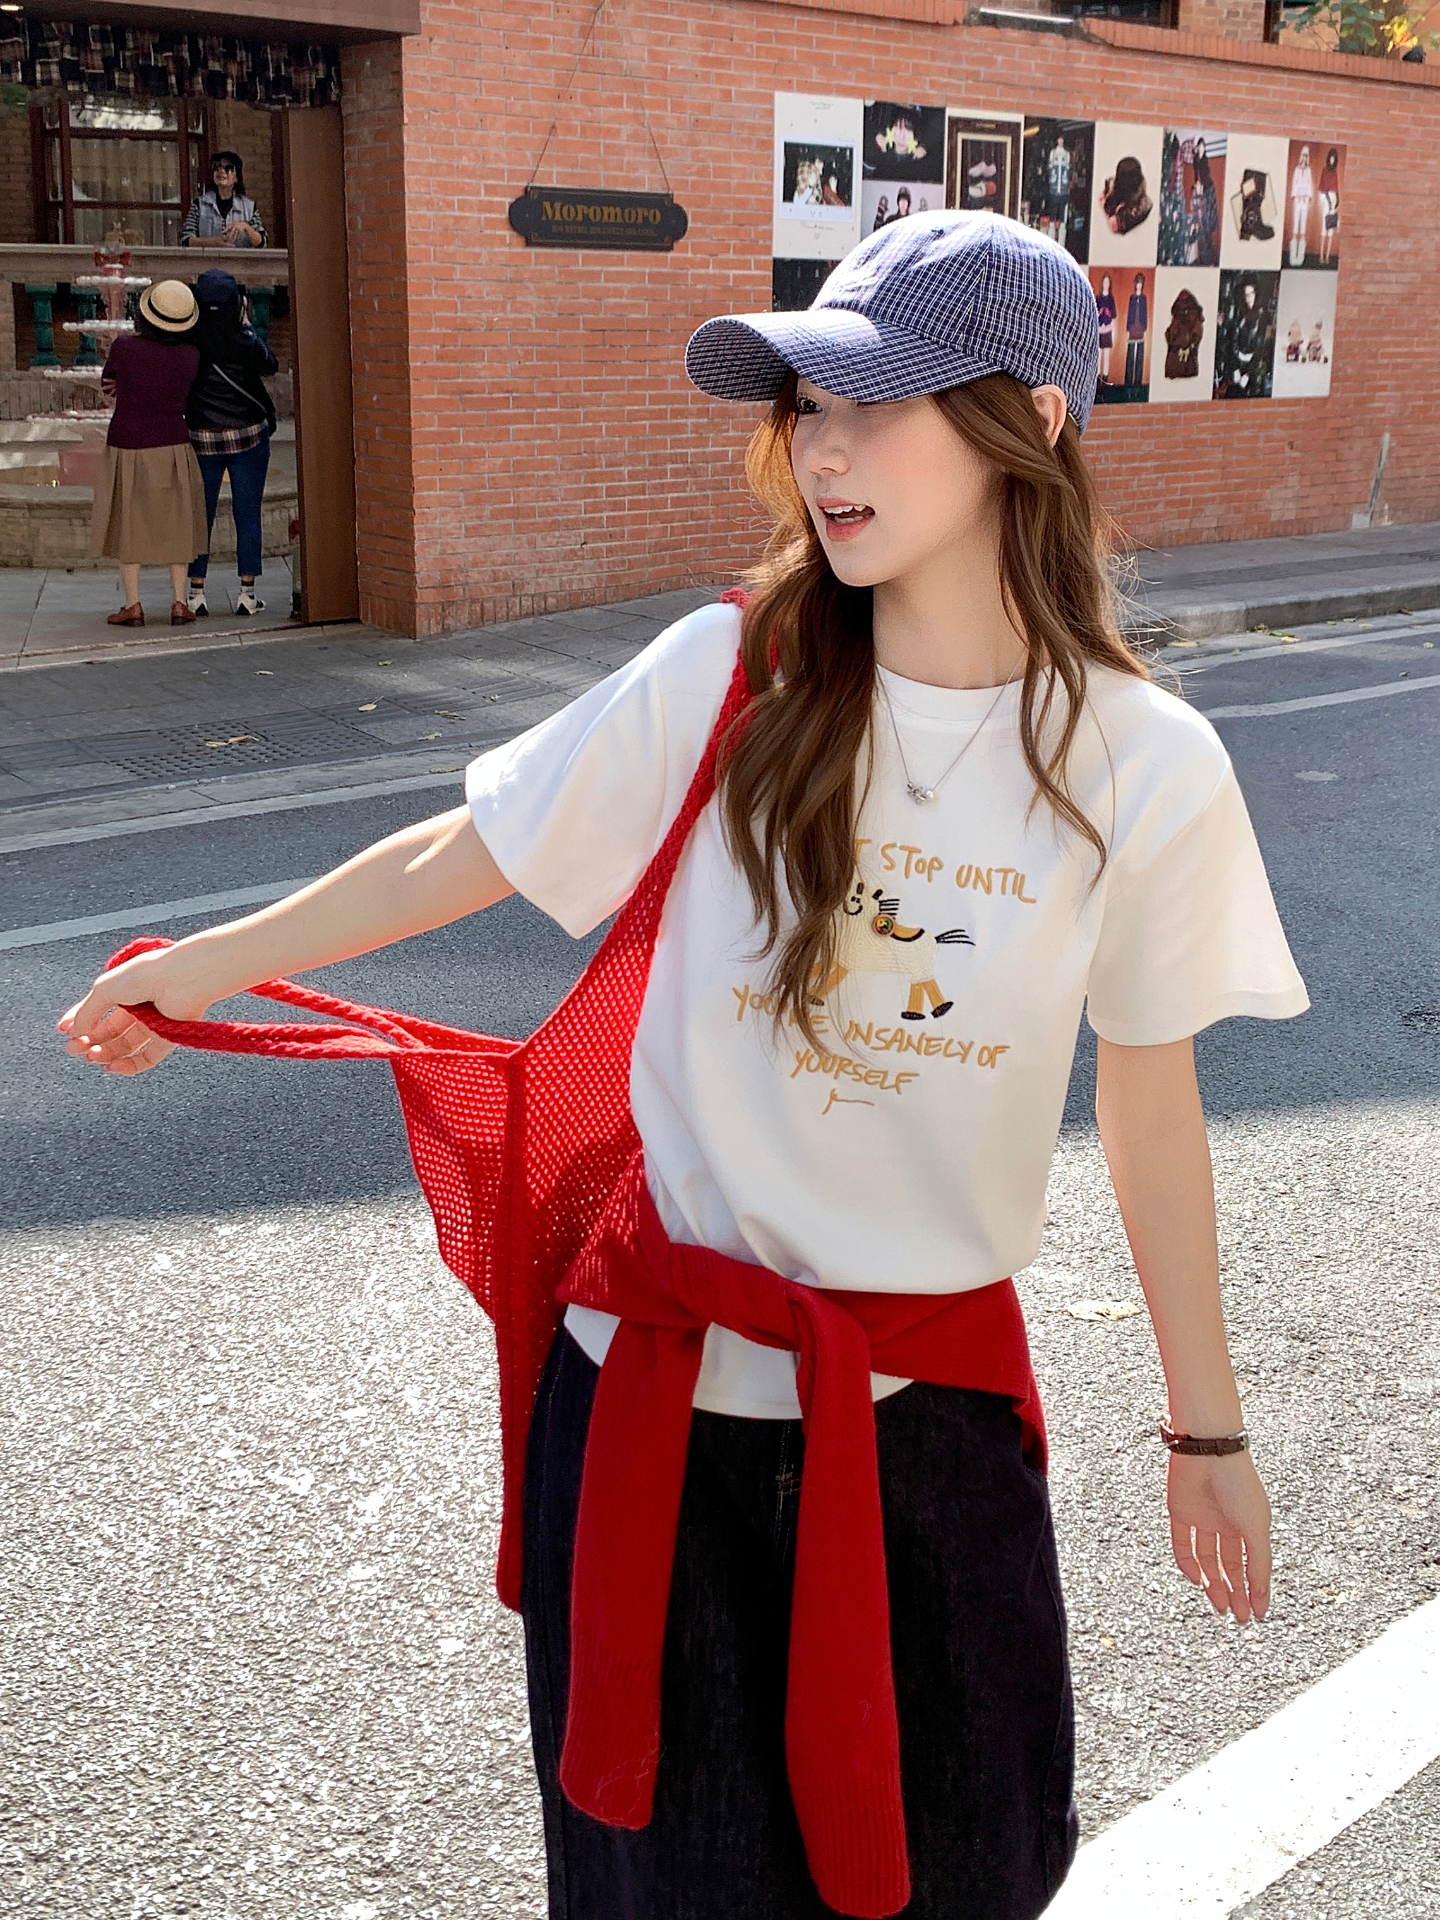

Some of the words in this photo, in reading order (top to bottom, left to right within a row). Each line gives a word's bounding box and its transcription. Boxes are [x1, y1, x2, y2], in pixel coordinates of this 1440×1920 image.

[542, 201, 661, 225] Moromoro
[880, 843, 943, 882] STOP
[956, 864, 1036, 903] UNTIL
[844, 1020, 974, 1065] INSANELY
[977, 1045, 1010, 1069] OF
[790, 1048, 919, 1094] YOURSELF
